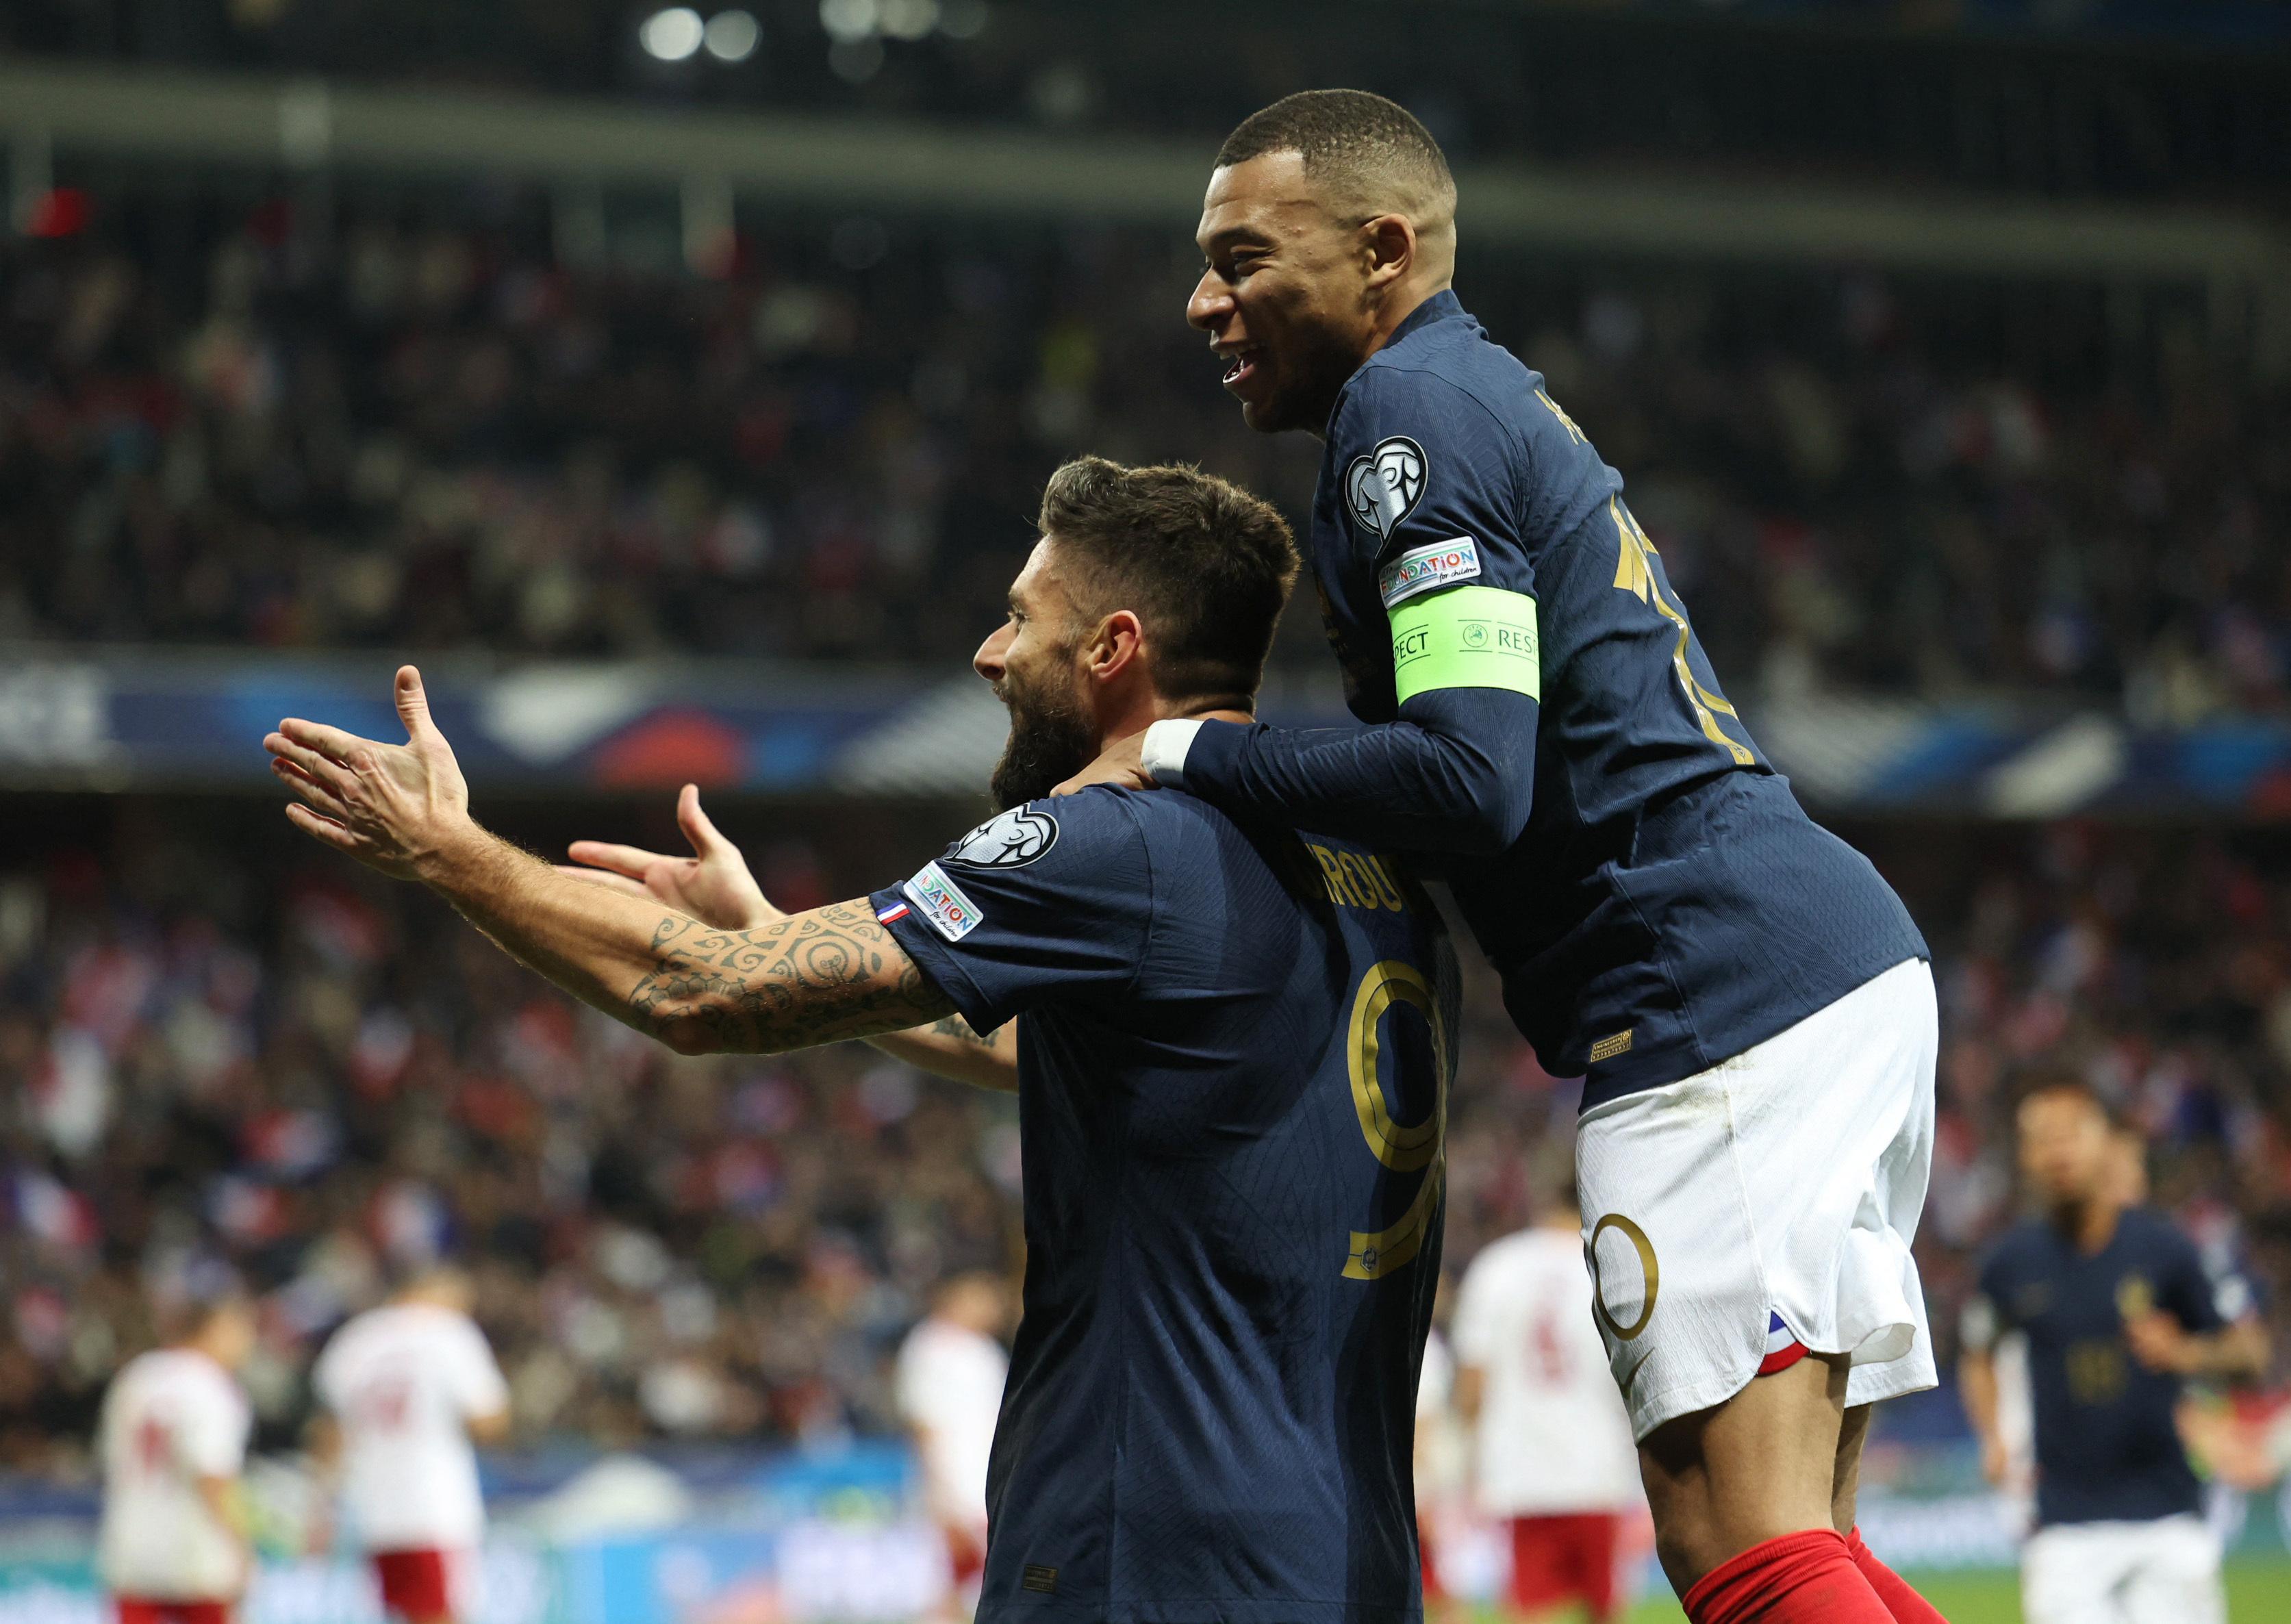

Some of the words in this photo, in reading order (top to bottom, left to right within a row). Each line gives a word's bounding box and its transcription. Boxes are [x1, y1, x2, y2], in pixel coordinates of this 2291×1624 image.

[1439, 572, 1452, 583] for
[1452, 568, 1477, 577] children
[916, 871, 972, 931] UNDATION
[1305, 843, 1402, 913] ROU
[930, 911, 940, 921] for
[939, 919, 958, 937] children
[1341, 960, 1445, 1280] 9
[1591, 1213, 1659, 1341] 0
